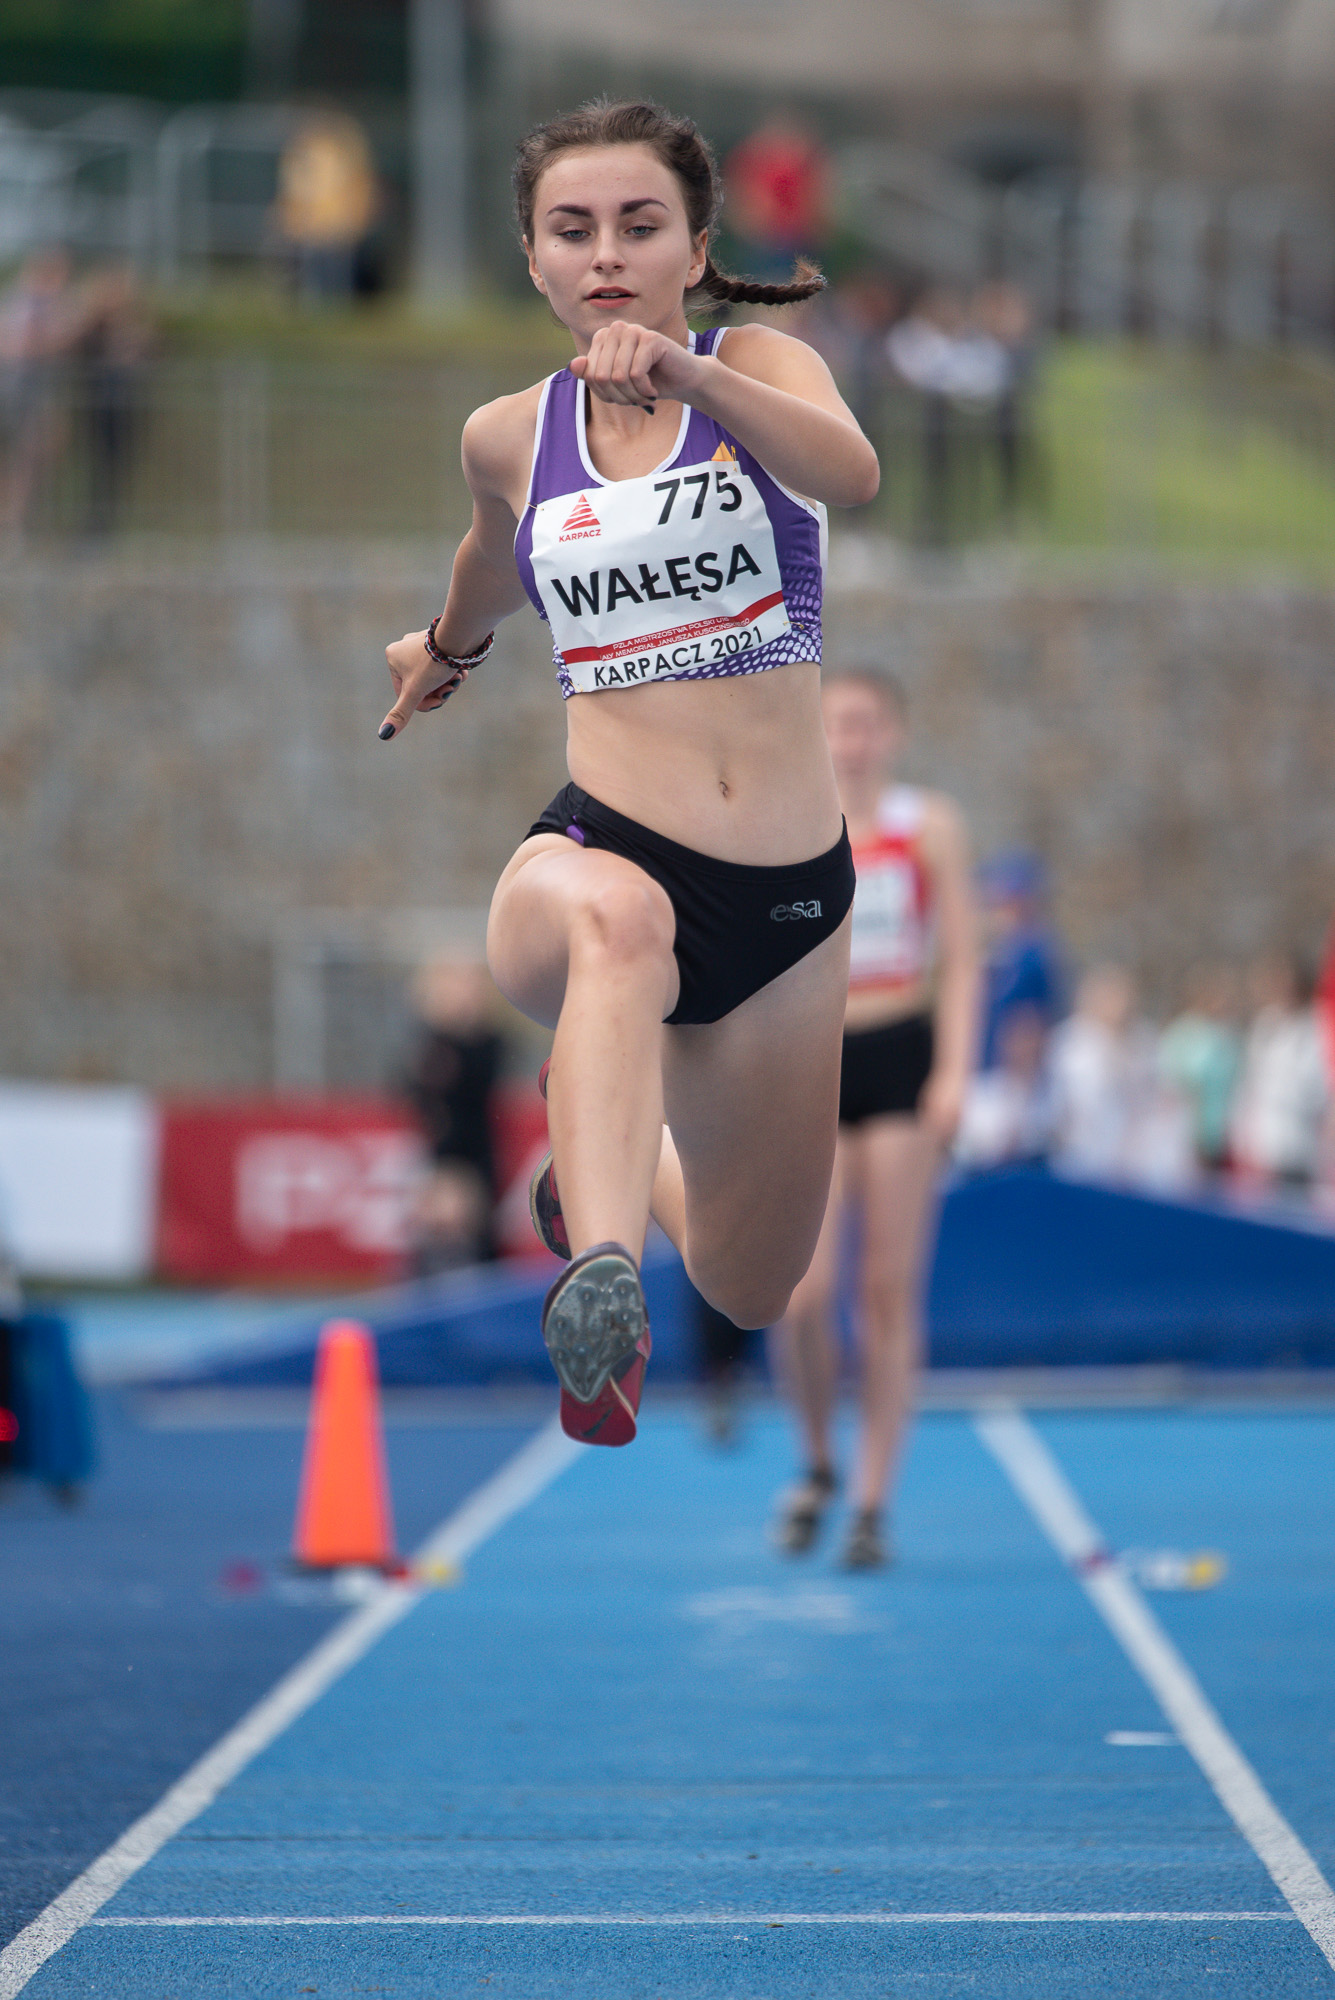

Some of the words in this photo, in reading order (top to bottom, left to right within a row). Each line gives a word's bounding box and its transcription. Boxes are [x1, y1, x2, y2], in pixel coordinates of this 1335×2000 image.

[654, 471, 743, 525] 775
[559, 529, 602, 543] KARPACZ
[551, 543, 762, 617] WAŁĘSA
[612, 641, 633, 650] PZLA
[634, 627, 688, 645] MISTRZOSTWA
[689, 618, 715, 631] POLSKI
[615, 643, 656, 657] MEMORIAŁ
[657, 633, 693, 647] JANUSZA
[594, 644, 706, 687] KARPACZ
[710, 626, 763, 658] 2021
